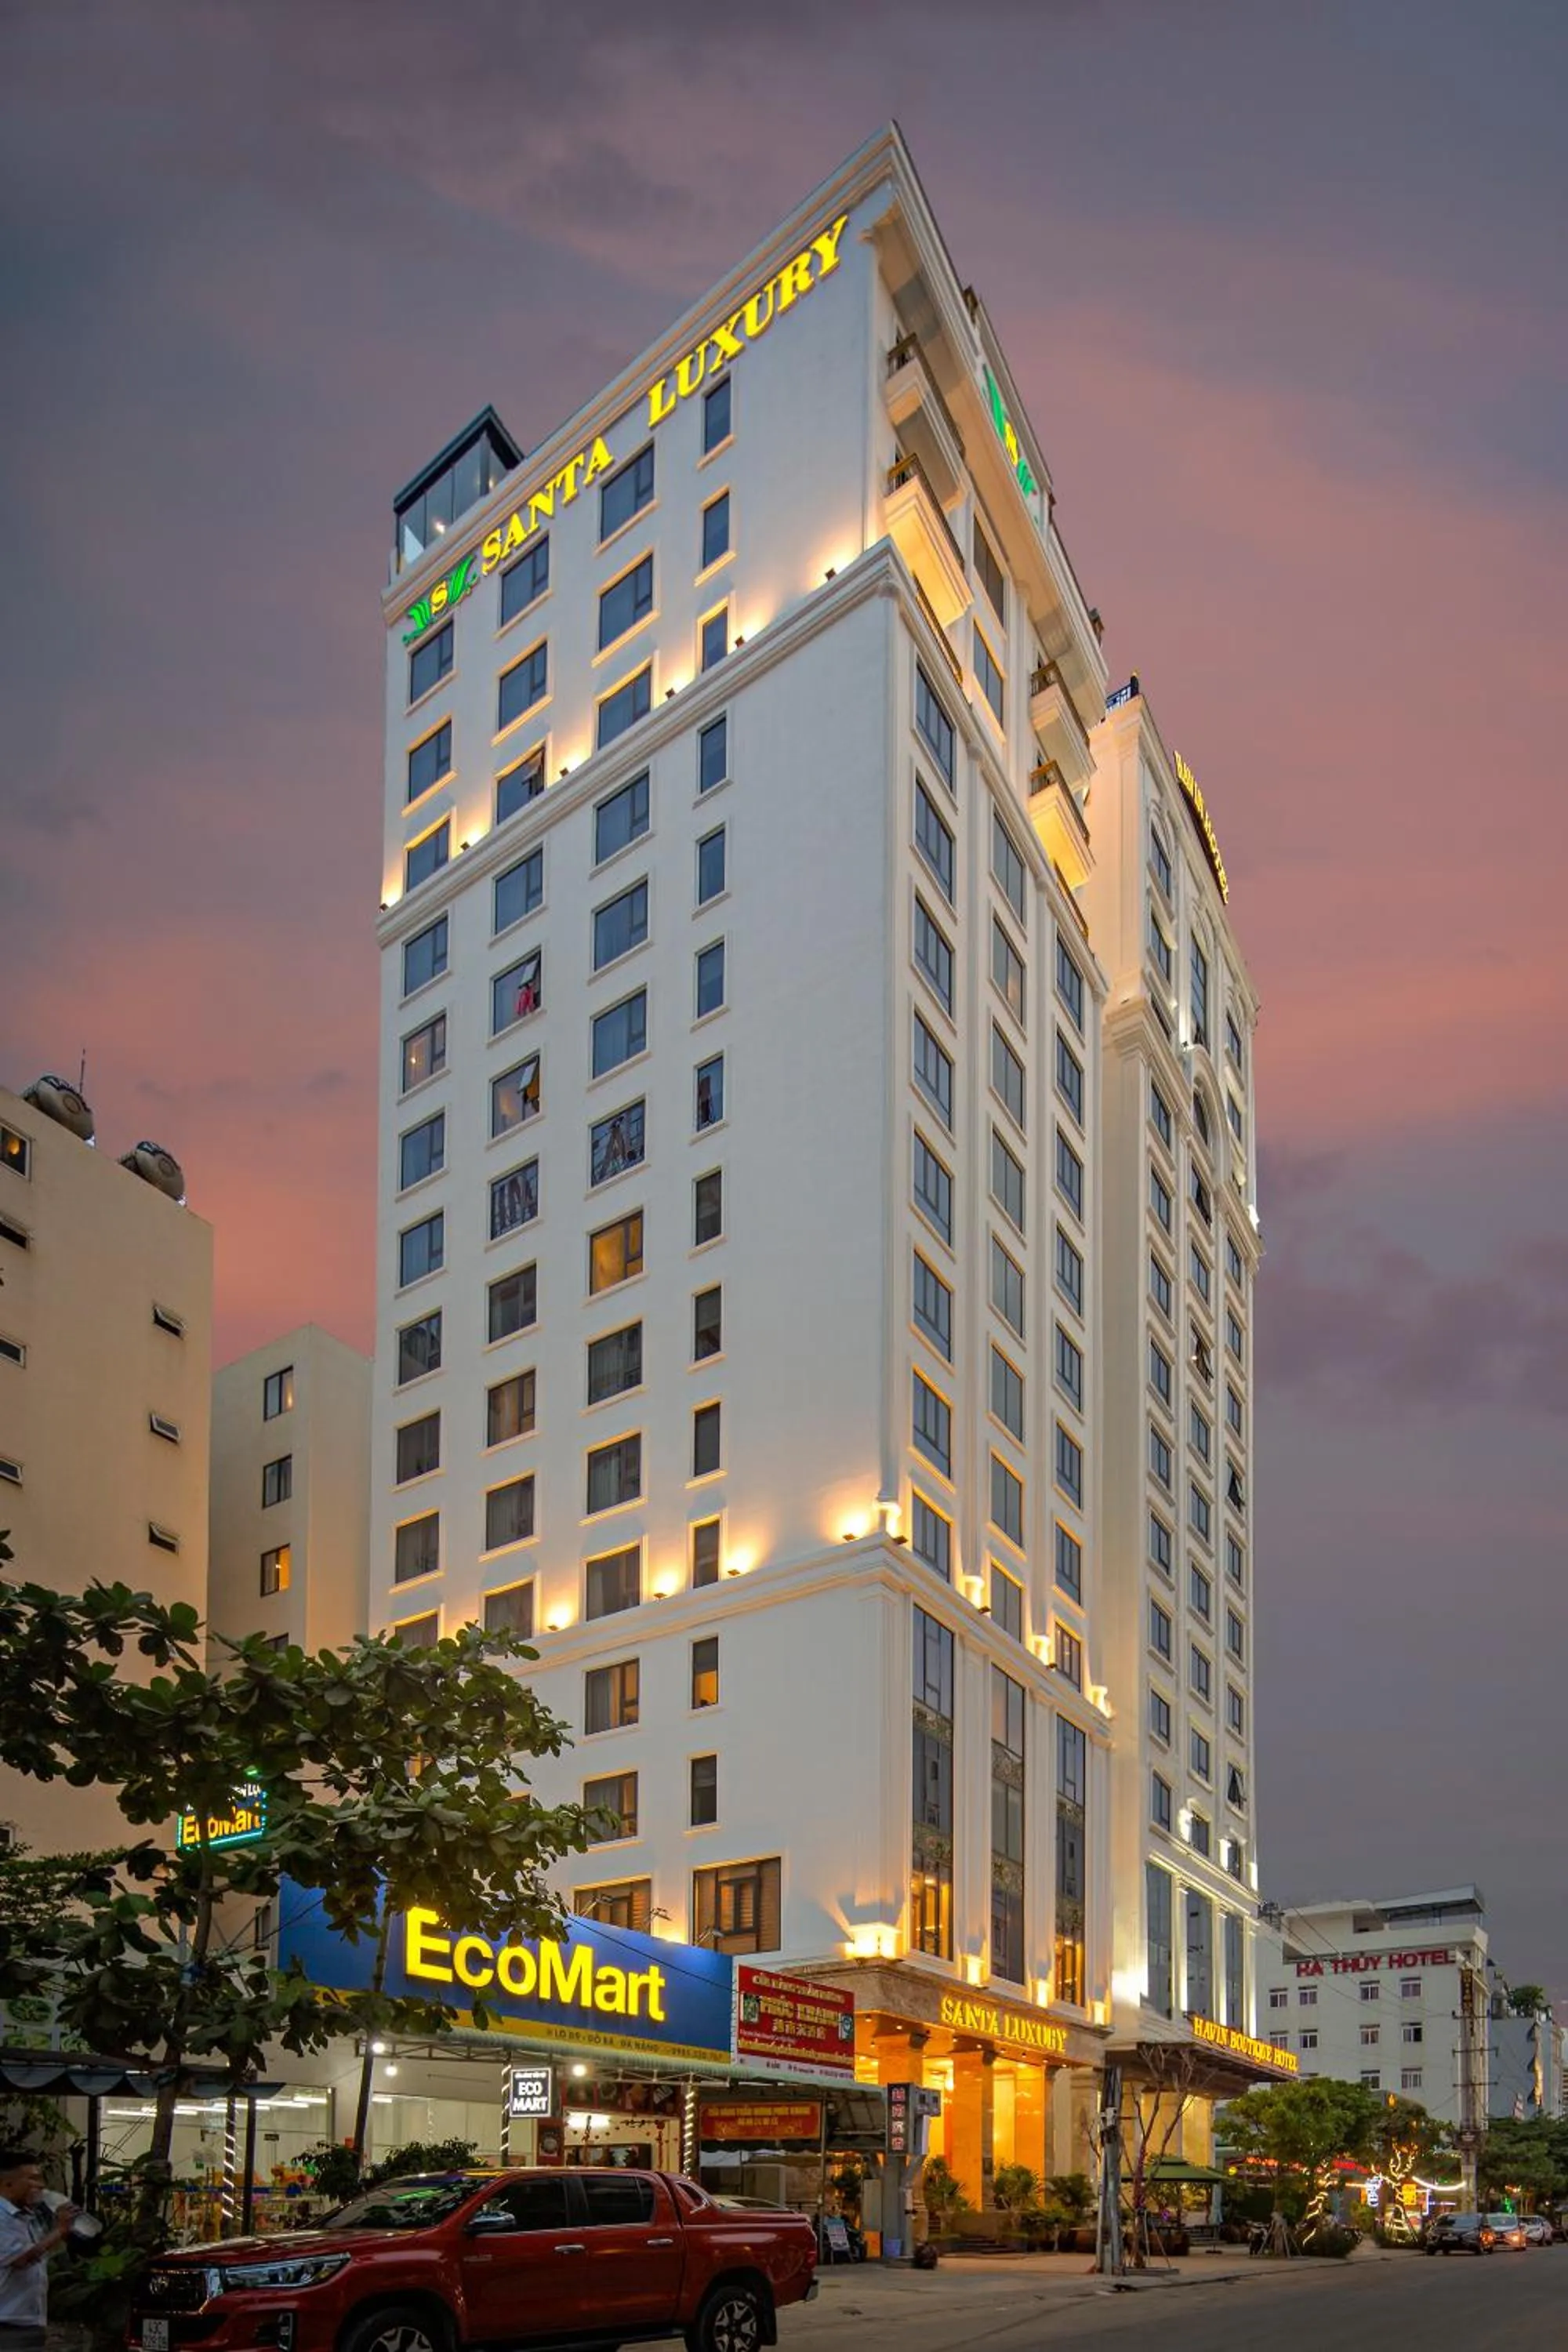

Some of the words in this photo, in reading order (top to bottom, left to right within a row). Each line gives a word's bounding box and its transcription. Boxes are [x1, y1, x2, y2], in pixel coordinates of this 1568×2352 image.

[481, 436, 614, 576] SANTA
[647, 213, 848, 428] LUXURY
[405, 1905, 666, 2023] EcoMart
[1388, 1949, 1457, 1969] HOTEL
[942, 1995, 1003, 2037] SANTA
[1004, 2013, 1067, 2053] LUXURY
[1194, 2016, 1229, 2046] HAVIN
[1229, 2031, 1273, 2065] BOUTIQUE
[1273, 2047, 1299, 2072] HOTEL
[513, 2096, 548, 2111] MART
[518, 2081, 543, 2096] ECO
